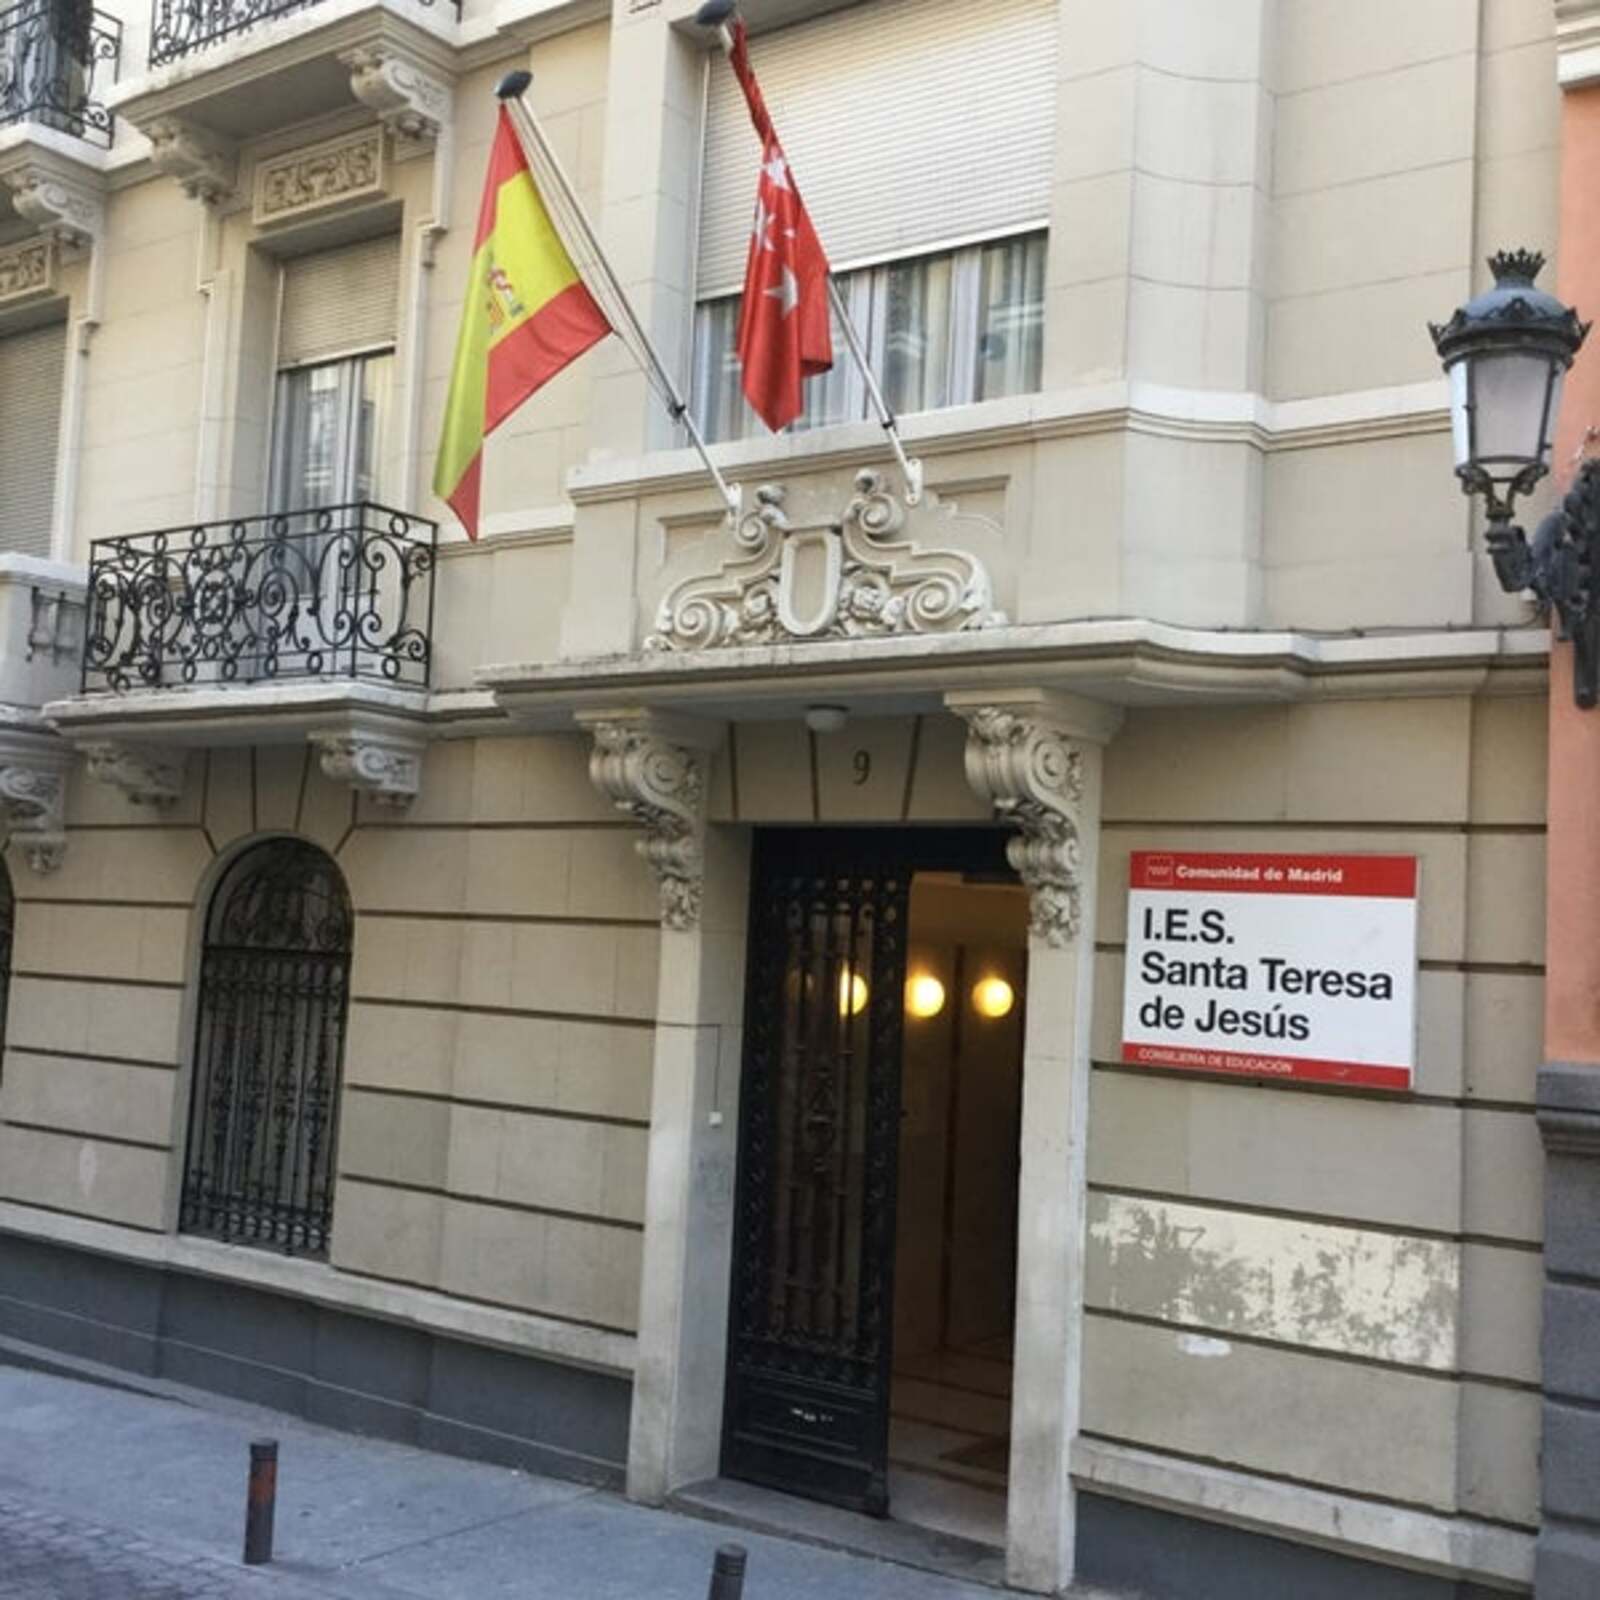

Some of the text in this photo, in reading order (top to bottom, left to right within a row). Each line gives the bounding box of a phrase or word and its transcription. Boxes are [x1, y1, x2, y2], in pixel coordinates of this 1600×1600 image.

[853, 750, 870, 786] 9
[1176, 865, 1343, 882] Comunidad de Madrid
[1144, 907, 1234, 944] I.E.S.
[1141, 951, 1393, 1000] Santa Teresa
[1140, 996, 1310, 1040] de Jesús
[1207, 1055, 1224, 1067] DE
